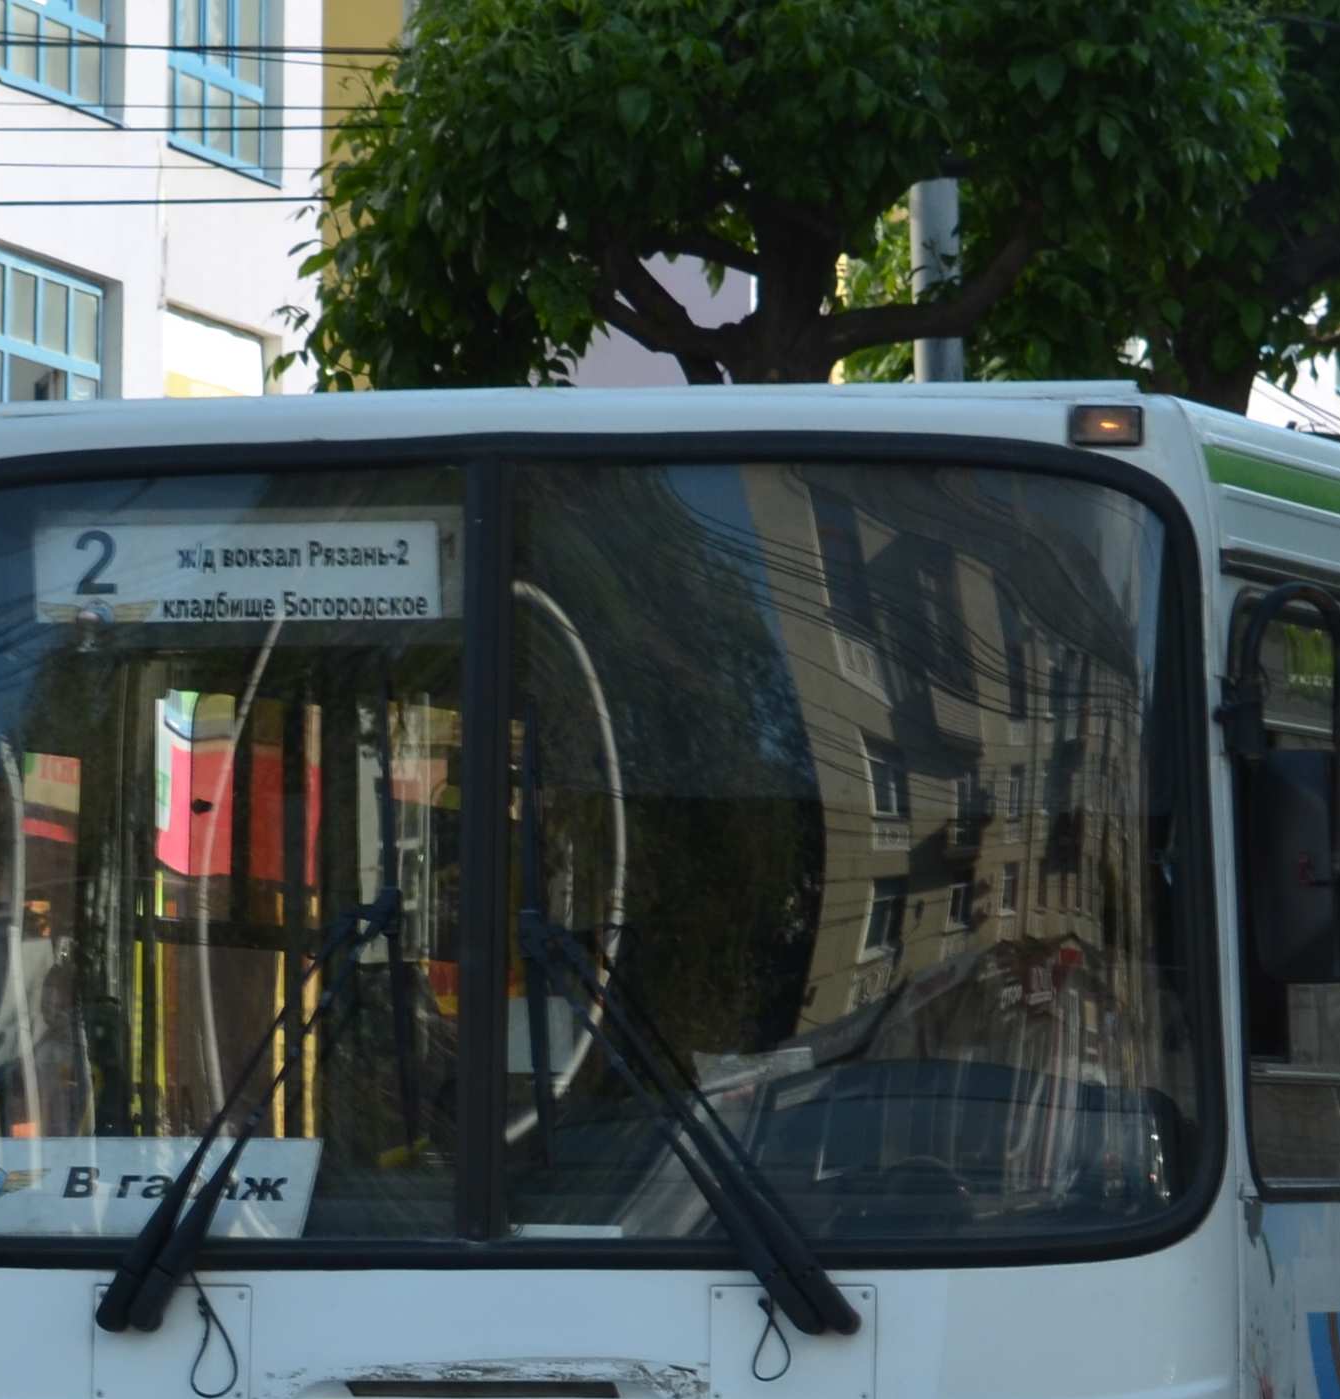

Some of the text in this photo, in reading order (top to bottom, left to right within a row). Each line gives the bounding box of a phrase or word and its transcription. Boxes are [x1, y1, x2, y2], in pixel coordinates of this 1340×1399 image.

[75, 530, 117, 594] 2
[177, 539, 409, 574] ж/д вокзал Рязань-2
[162, 590, 429, 620] кладбище Богородское
[62, 1166, 100, 1199] В
